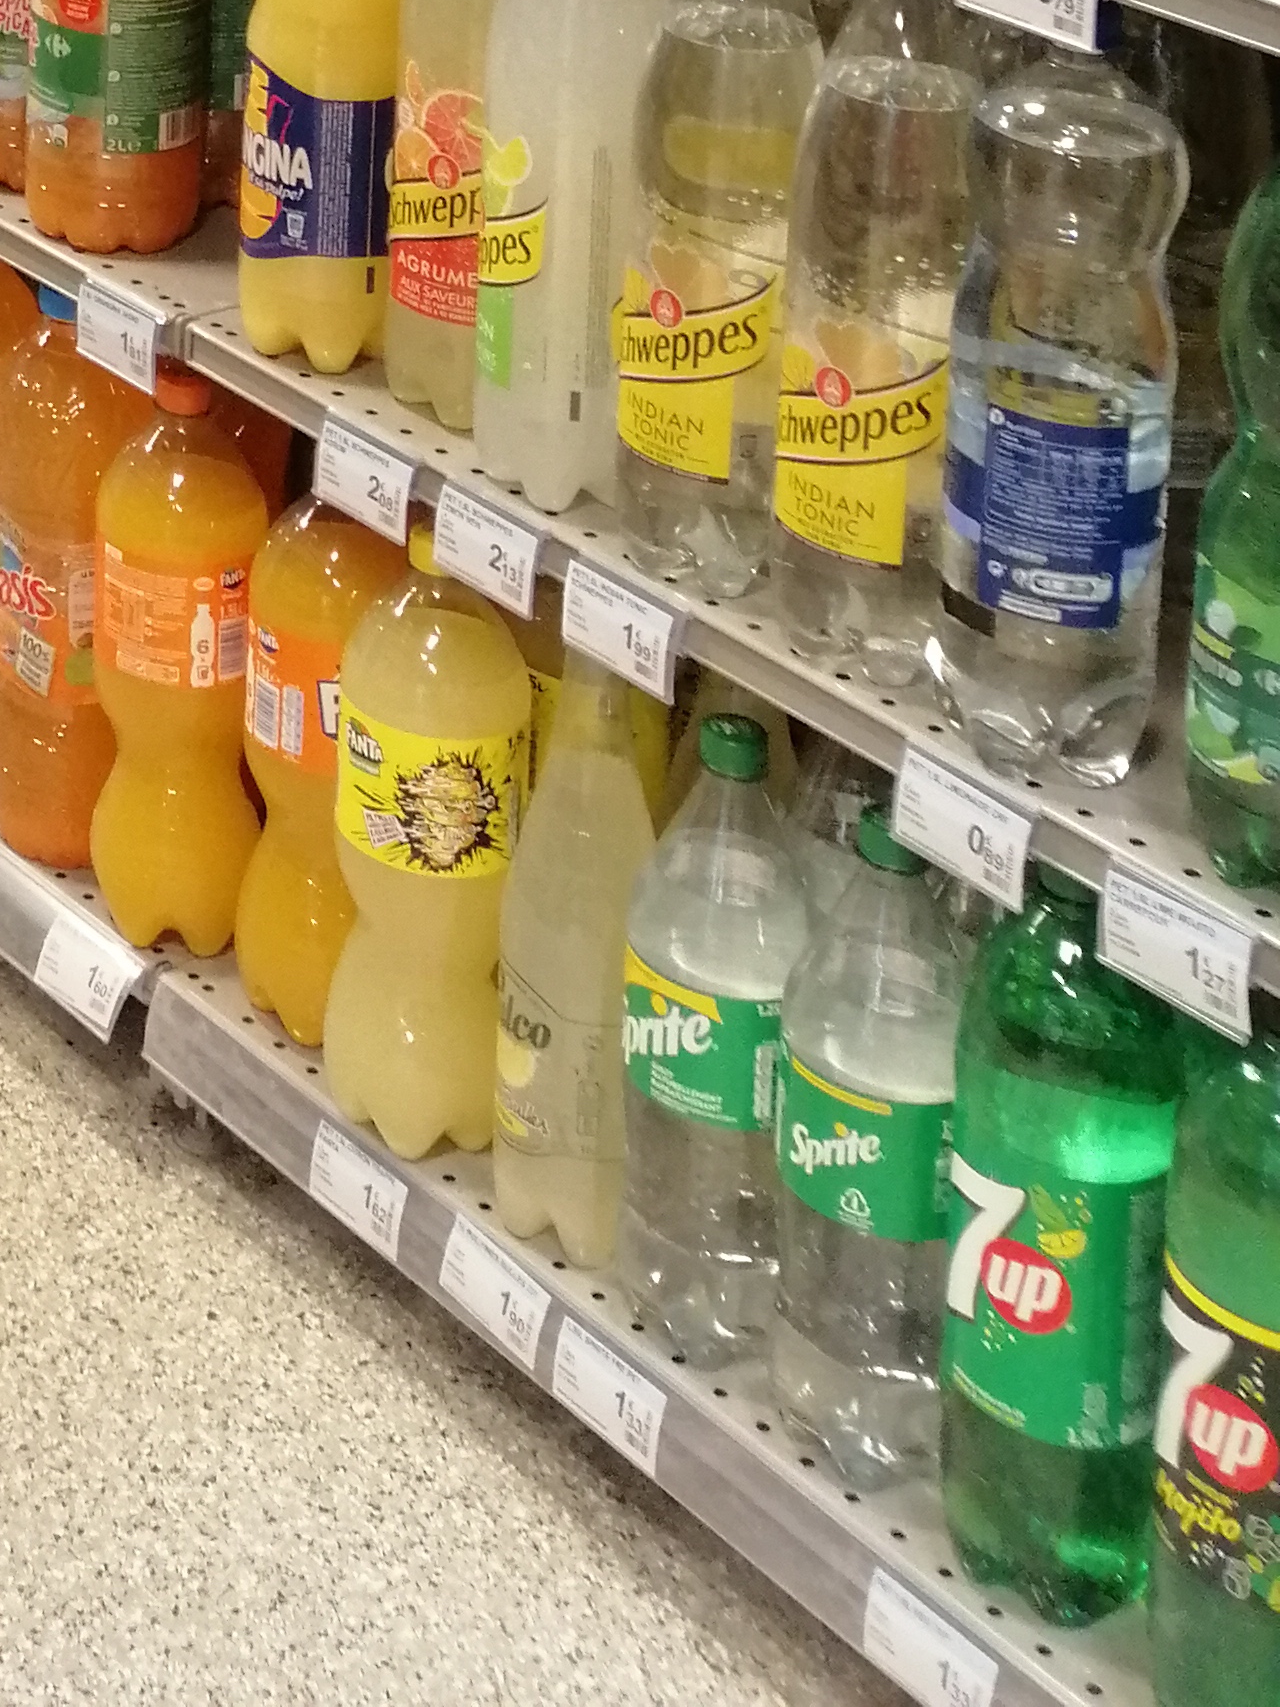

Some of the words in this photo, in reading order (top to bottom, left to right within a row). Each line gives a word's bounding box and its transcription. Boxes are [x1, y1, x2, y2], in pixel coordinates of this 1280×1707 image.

[626, 386, 705, 436] INDIAN
[631, 414, 690, 451] TONIC
[789, 475, 876, 521] INDIAN
[794, 497, 860, 538] TONIC
[790, 1122, 881, 1175] Sprite
[946, 1150, 1026, 1321] 7
[991, 1252, 1064, 1321] up
[1190, 1403, 1271, 1476] up
